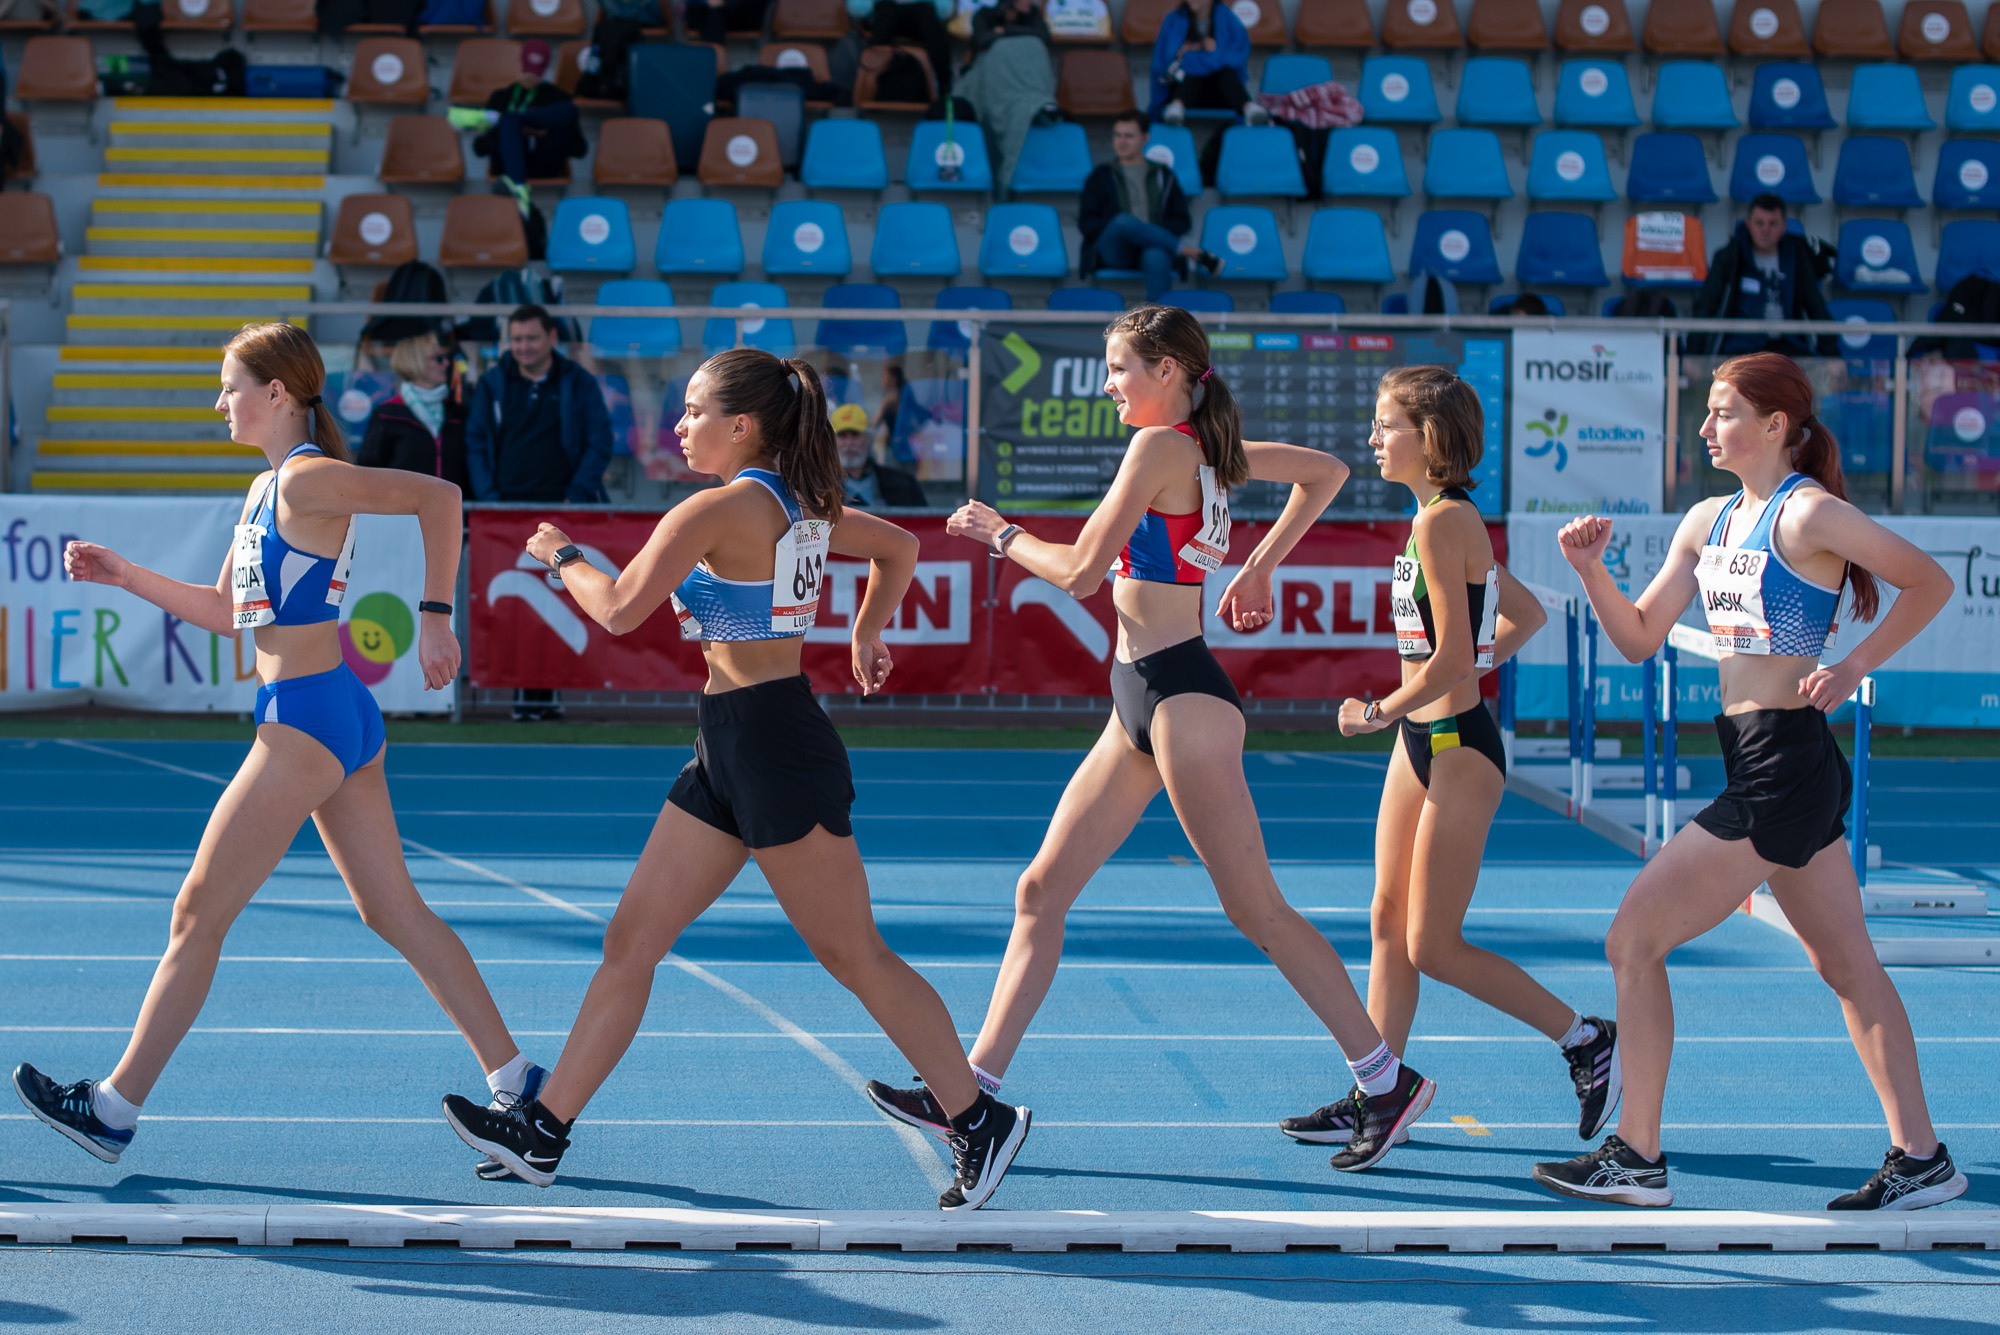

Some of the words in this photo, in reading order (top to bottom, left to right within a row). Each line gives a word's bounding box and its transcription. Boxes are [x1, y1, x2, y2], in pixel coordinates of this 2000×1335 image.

[1525, 351, 1614, 381] mosir
[1022, 398, 1128, 437] team
[1577, 425, 1645, 440] stadion
[1394, 561, 1413, 582] 38
[1729, 553, 1761, 576] 638
[793, 554, 822, 601] 641
[1707, 590, 1748, 613] JASIK
[0, 606, 129, 691] IER
[1733, 637, 1752, 649] 2022
